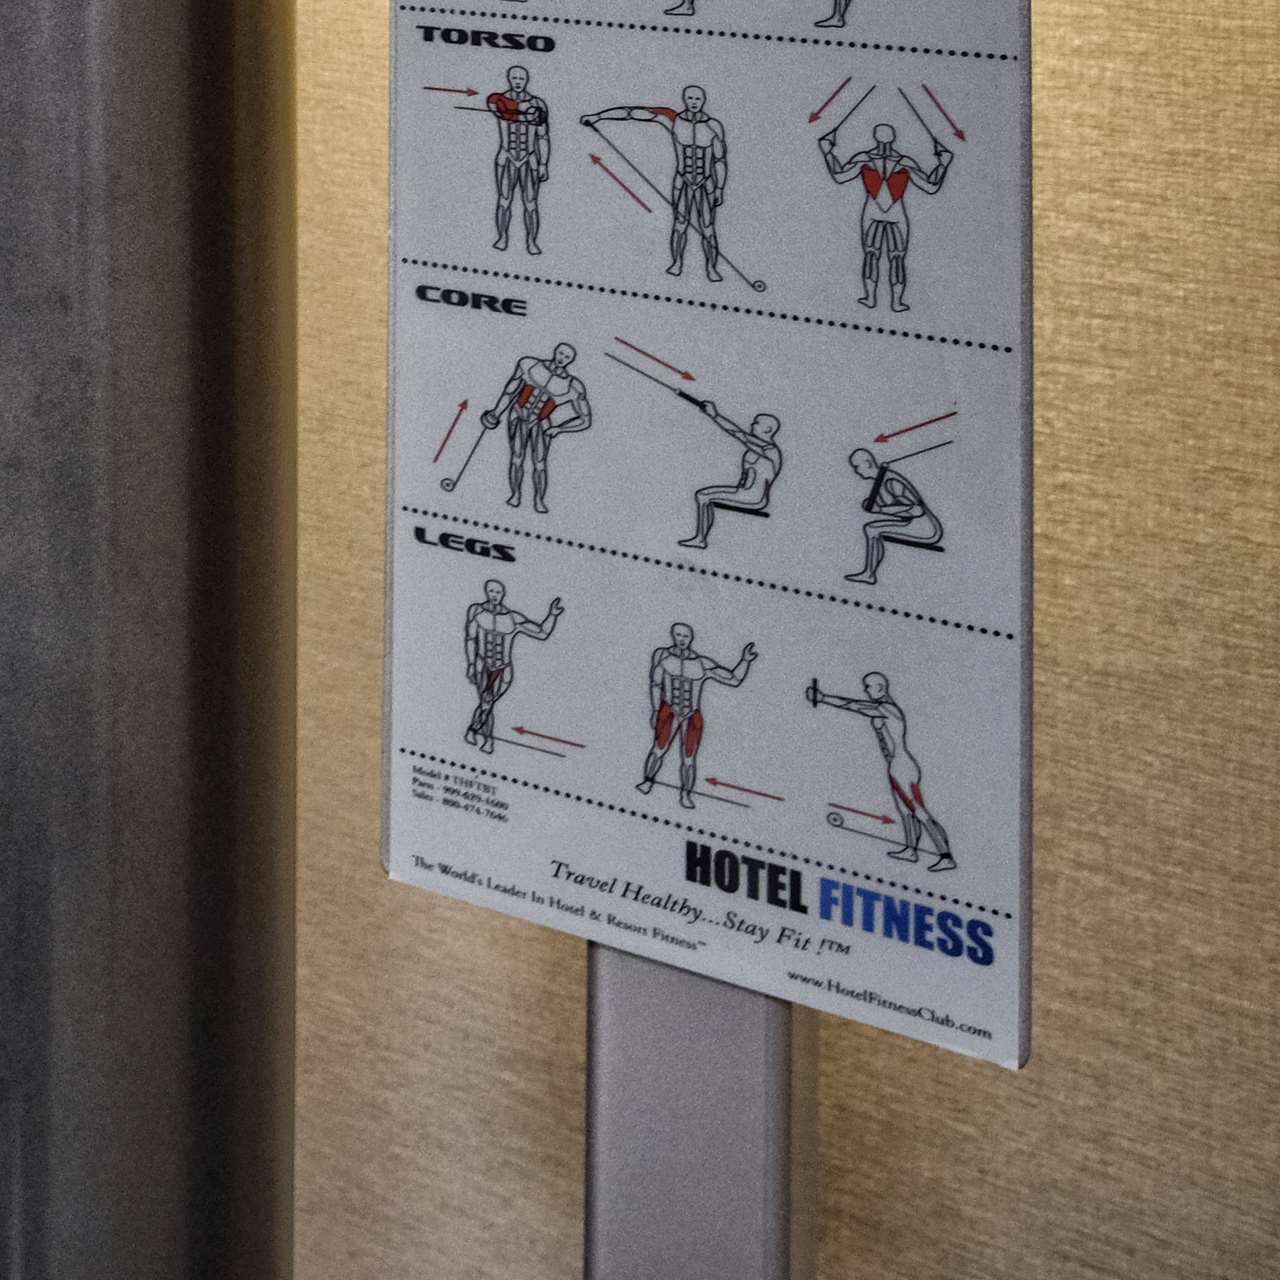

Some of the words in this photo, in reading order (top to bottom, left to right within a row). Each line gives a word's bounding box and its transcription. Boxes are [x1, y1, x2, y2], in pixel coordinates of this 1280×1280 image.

[416, 25, 556, 52] TORSO
[415, 284, 527, 317] CORE
[414, 526, 516, 562] LEGS
[411, 853, 434, 872] The
[438, 862, 484, 887] World's
[486, 876, 528, 900] Leader
[531, 890, 545, 905] In
[549, 895, 586, 918] Hotel
[590, 908, 602, 922] &
[606, 912, 649, 937] Resort
[550, 858, 618, 895] Travel
[776, 925, 811, 952] Fit
[685, 840, 809, 915] HOTEL
[819, 876, 996, 967] FITNESS
[787, 971, 993, 1040] www.HotelFitnessClub.com
